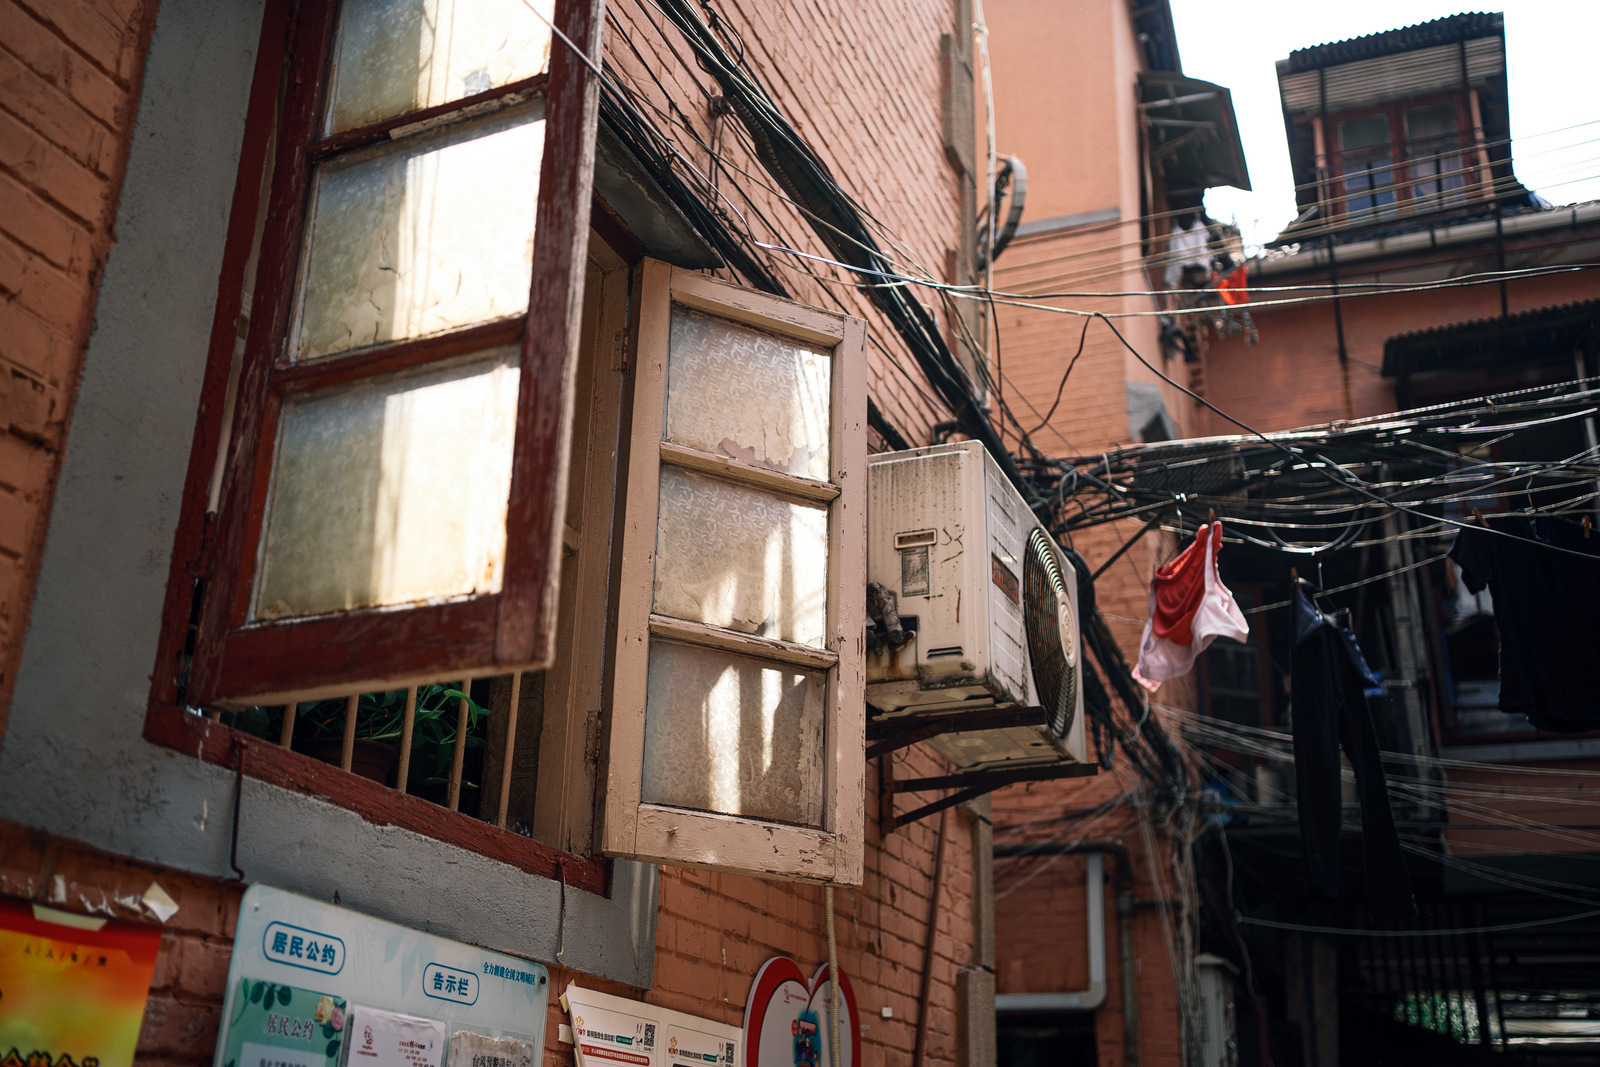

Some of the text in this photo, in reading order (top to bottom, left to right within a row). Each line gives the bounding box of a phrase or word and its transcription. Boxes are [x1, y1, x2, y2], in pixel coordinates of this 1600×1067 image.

[271, 930, 336, 967] 居民公约
[433, 971, 470, 997] 告示栏
[264, 1013, 314, 1041] 居民公约
